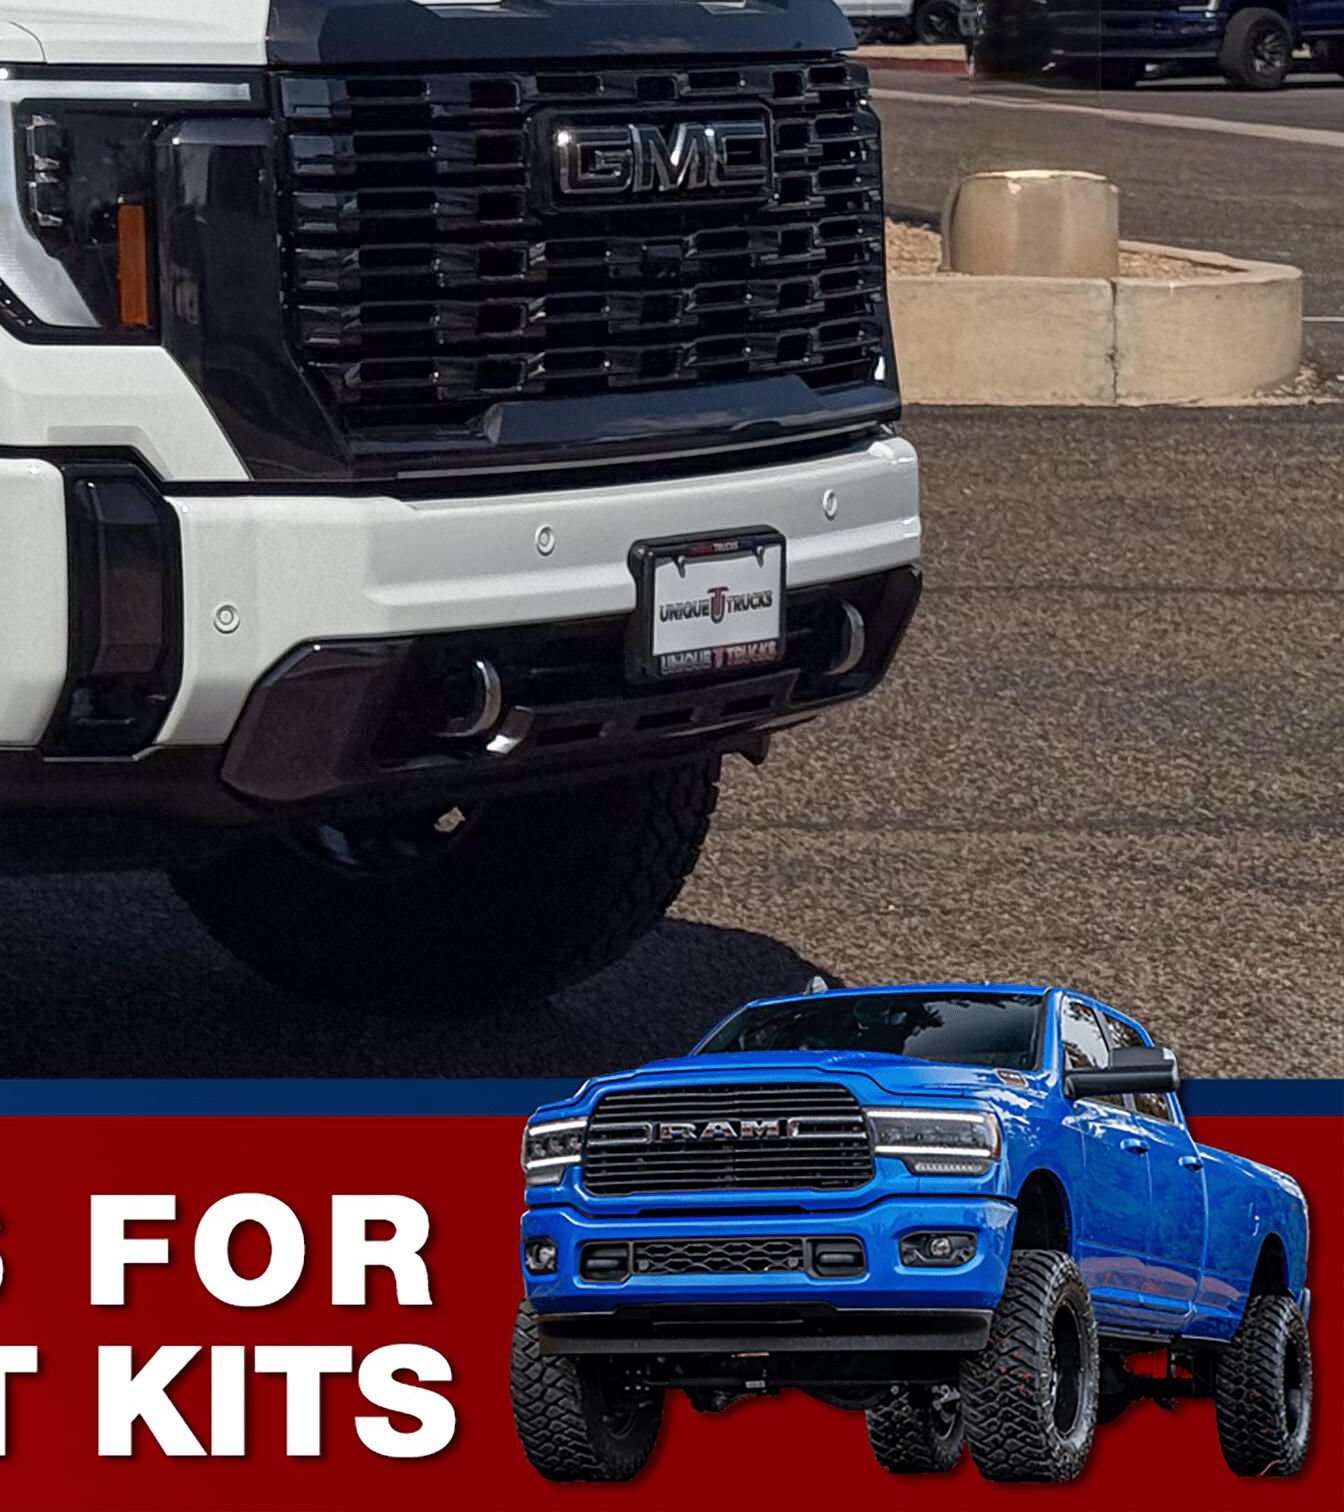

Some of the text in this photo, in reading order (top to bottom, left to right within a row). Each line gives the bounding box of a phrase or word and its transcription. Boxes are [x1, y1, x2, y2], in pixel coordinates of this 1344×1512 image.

[559, 122, 767, 194] GMC
[659, 599, 709, 623] UNIQUE
[726, 590, 773, 614] TRUCKS
